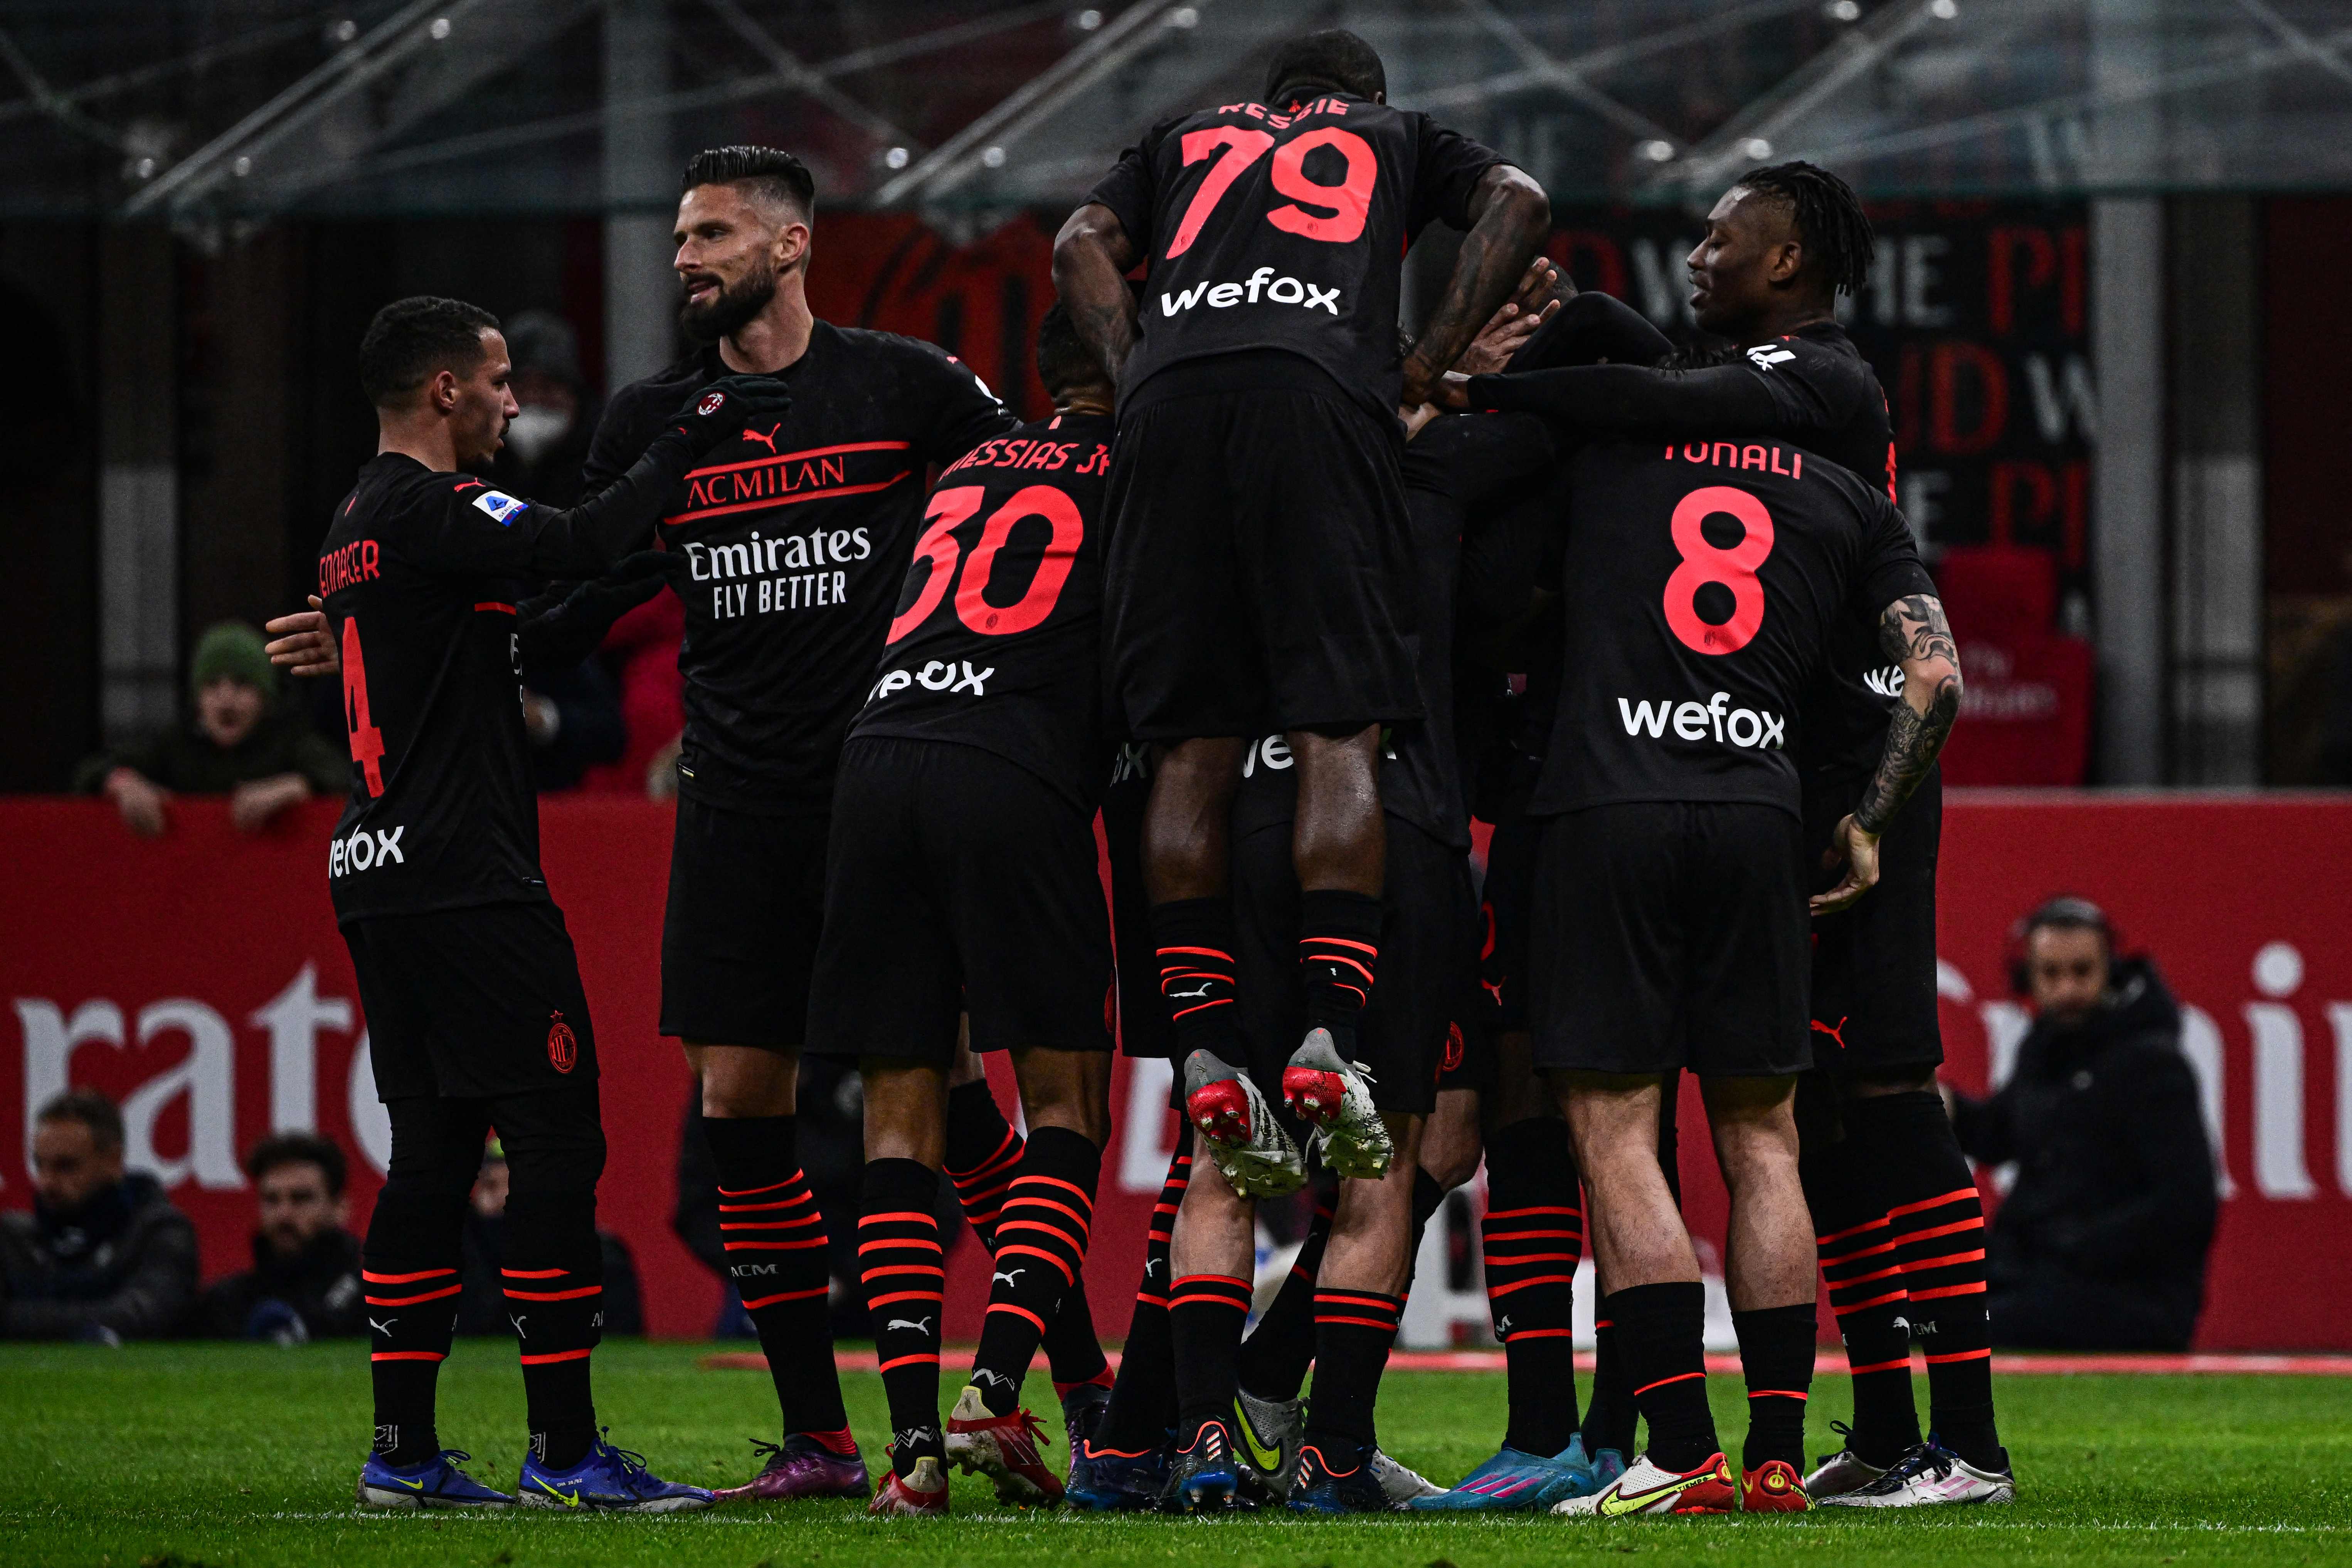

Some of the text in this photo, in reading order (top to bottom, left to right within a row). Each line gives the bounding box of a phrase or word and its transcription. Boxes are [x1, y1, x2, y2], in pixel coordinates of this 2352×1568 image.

[1166, 125, 1377, 259] 79
[1161, 267, 1341, 317] wefox
[687, 456, 844, 508] AC MILAN
[319, 539, 381, 599] ENNACER
[682, 526, 871, 581] Emirates
[886, 485, 1083, 645] 30
[1663, 485, 1774, 656] 8
[713, 570, 846, 619] FLY BETTER
[342, 616, 386, 799] 4
[1617, 691, 1785, 750] wefox
[730, 1263, 779, 1277] ACM
[1677, 1477, 1708, 1491] TIEMPO
